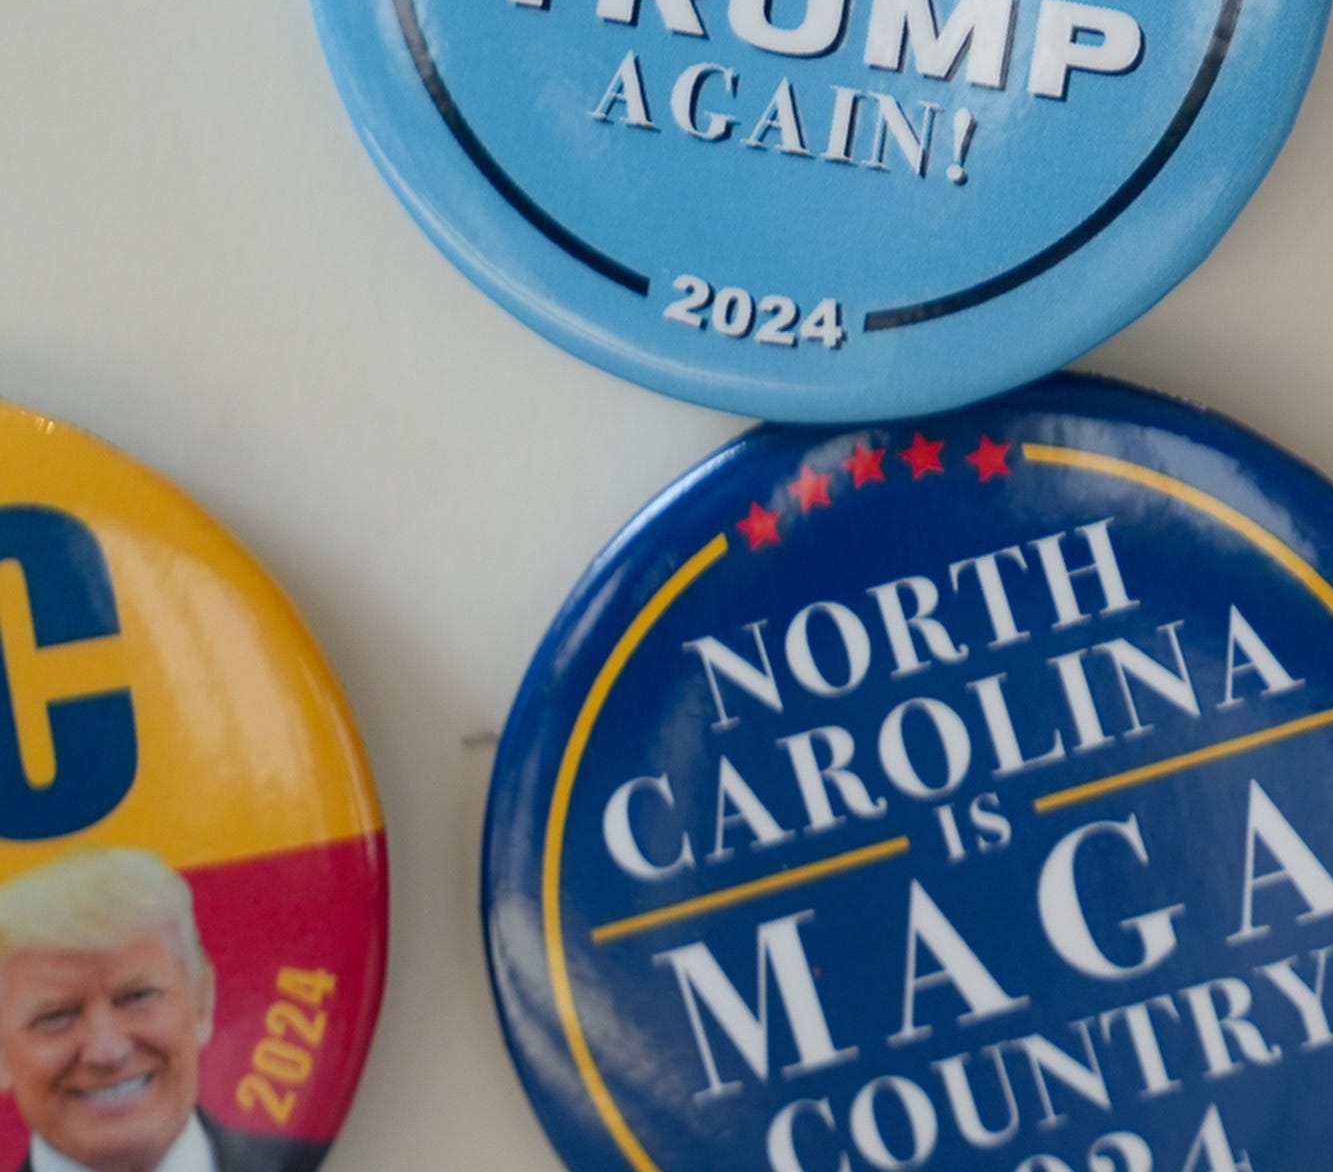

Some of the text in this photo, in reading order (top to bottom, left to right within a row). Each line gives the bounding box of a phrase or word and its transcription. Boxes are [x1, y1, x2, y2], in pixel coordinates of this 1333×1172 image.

[589, 49, 976, 185] AGAIN!
[662, 274, 847, 349] 2024
[682, 518, 1140, 731] NORTH
[601, 604, 1305, 882] CAROLINA
[933, 790, 1012, 861] IS
[237, 966, 337, 1126] 2024
